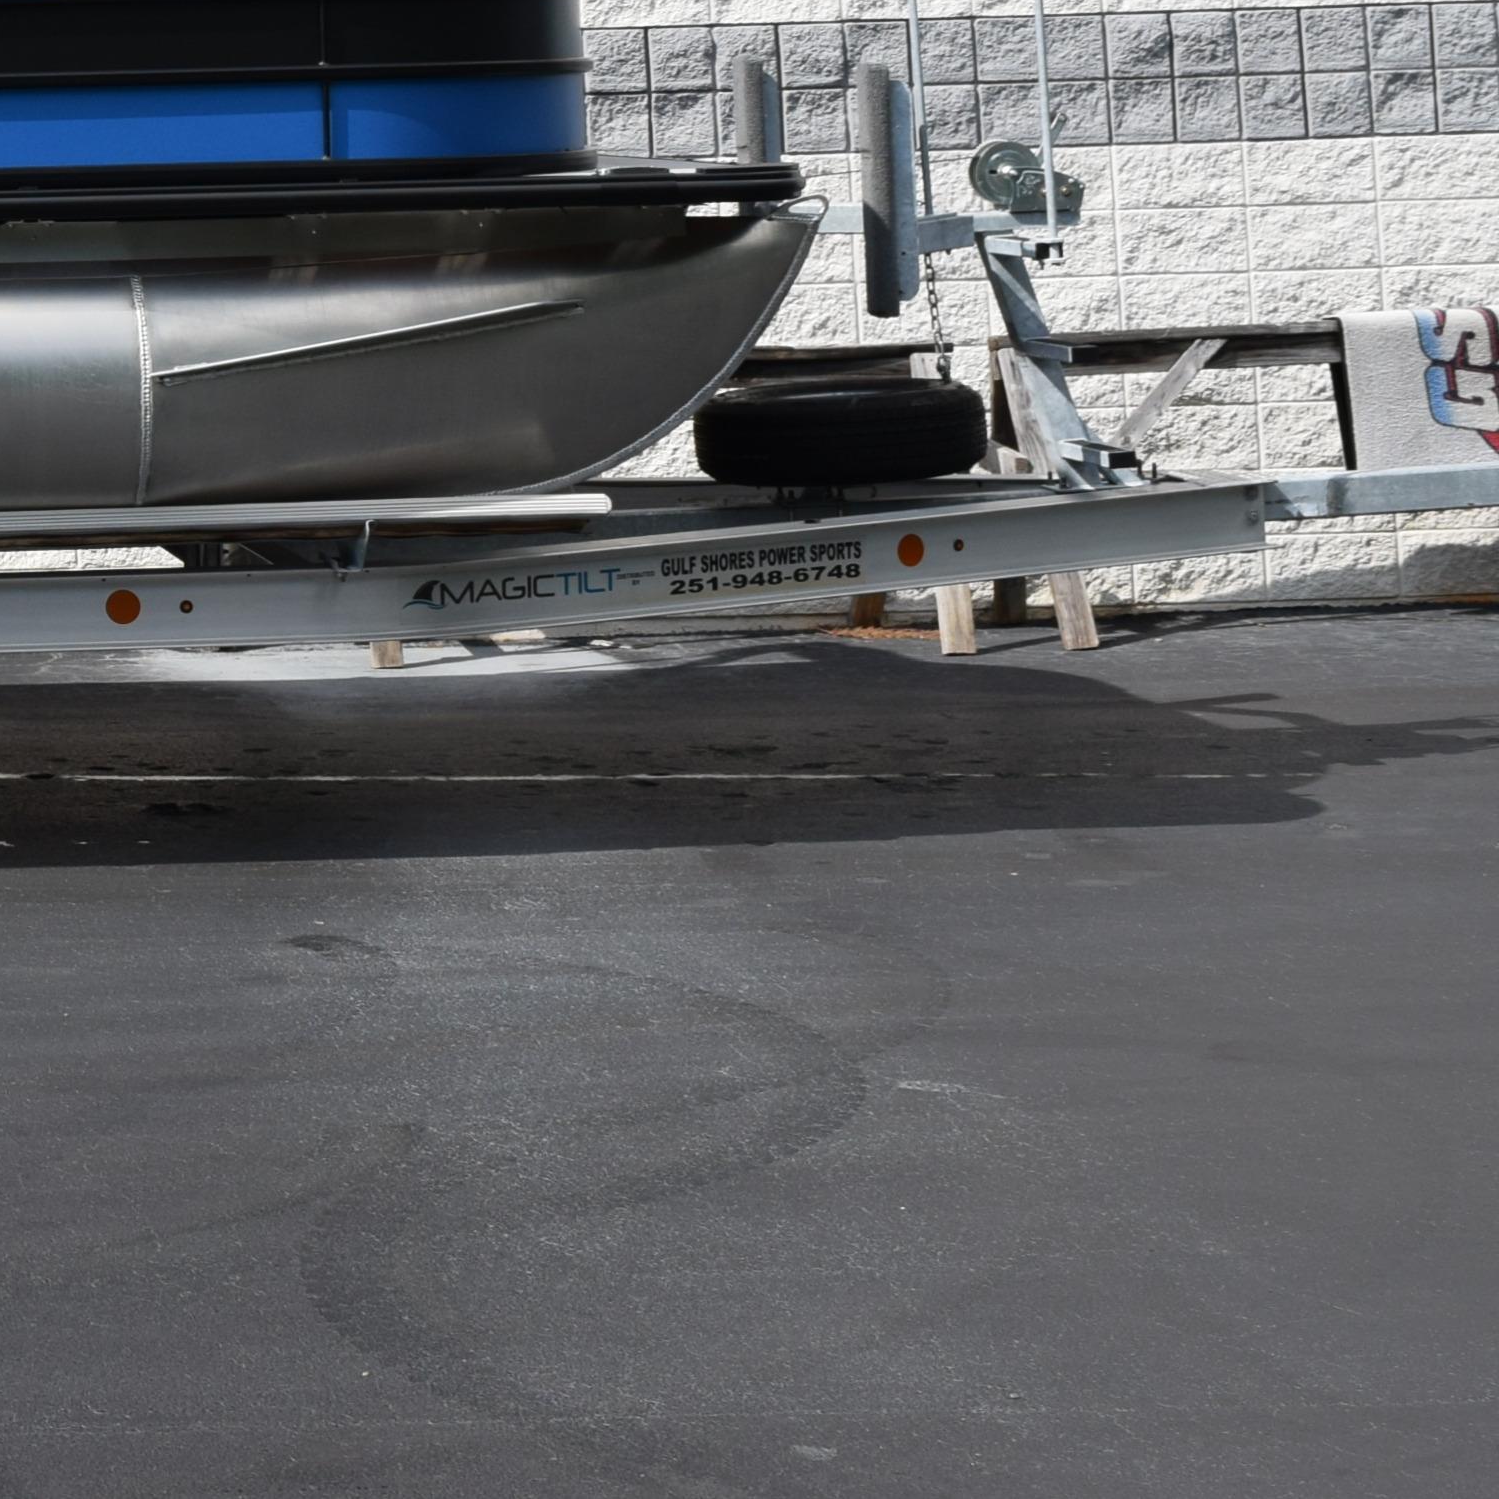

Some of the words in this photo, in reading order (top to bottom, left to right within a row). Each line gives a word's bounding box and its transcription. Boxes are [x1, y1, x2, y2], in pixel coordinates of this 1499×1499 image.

[661, 555, 697, 577] GULF
[700, 549, 756, 574] SHORES
[758, 545, 807, 568] POWER
[809, 540, 863, 563] SPORTS
[439, 567, 622, 606] MAGICTILT
[669, 562, 862, 596] 251-948-6748
